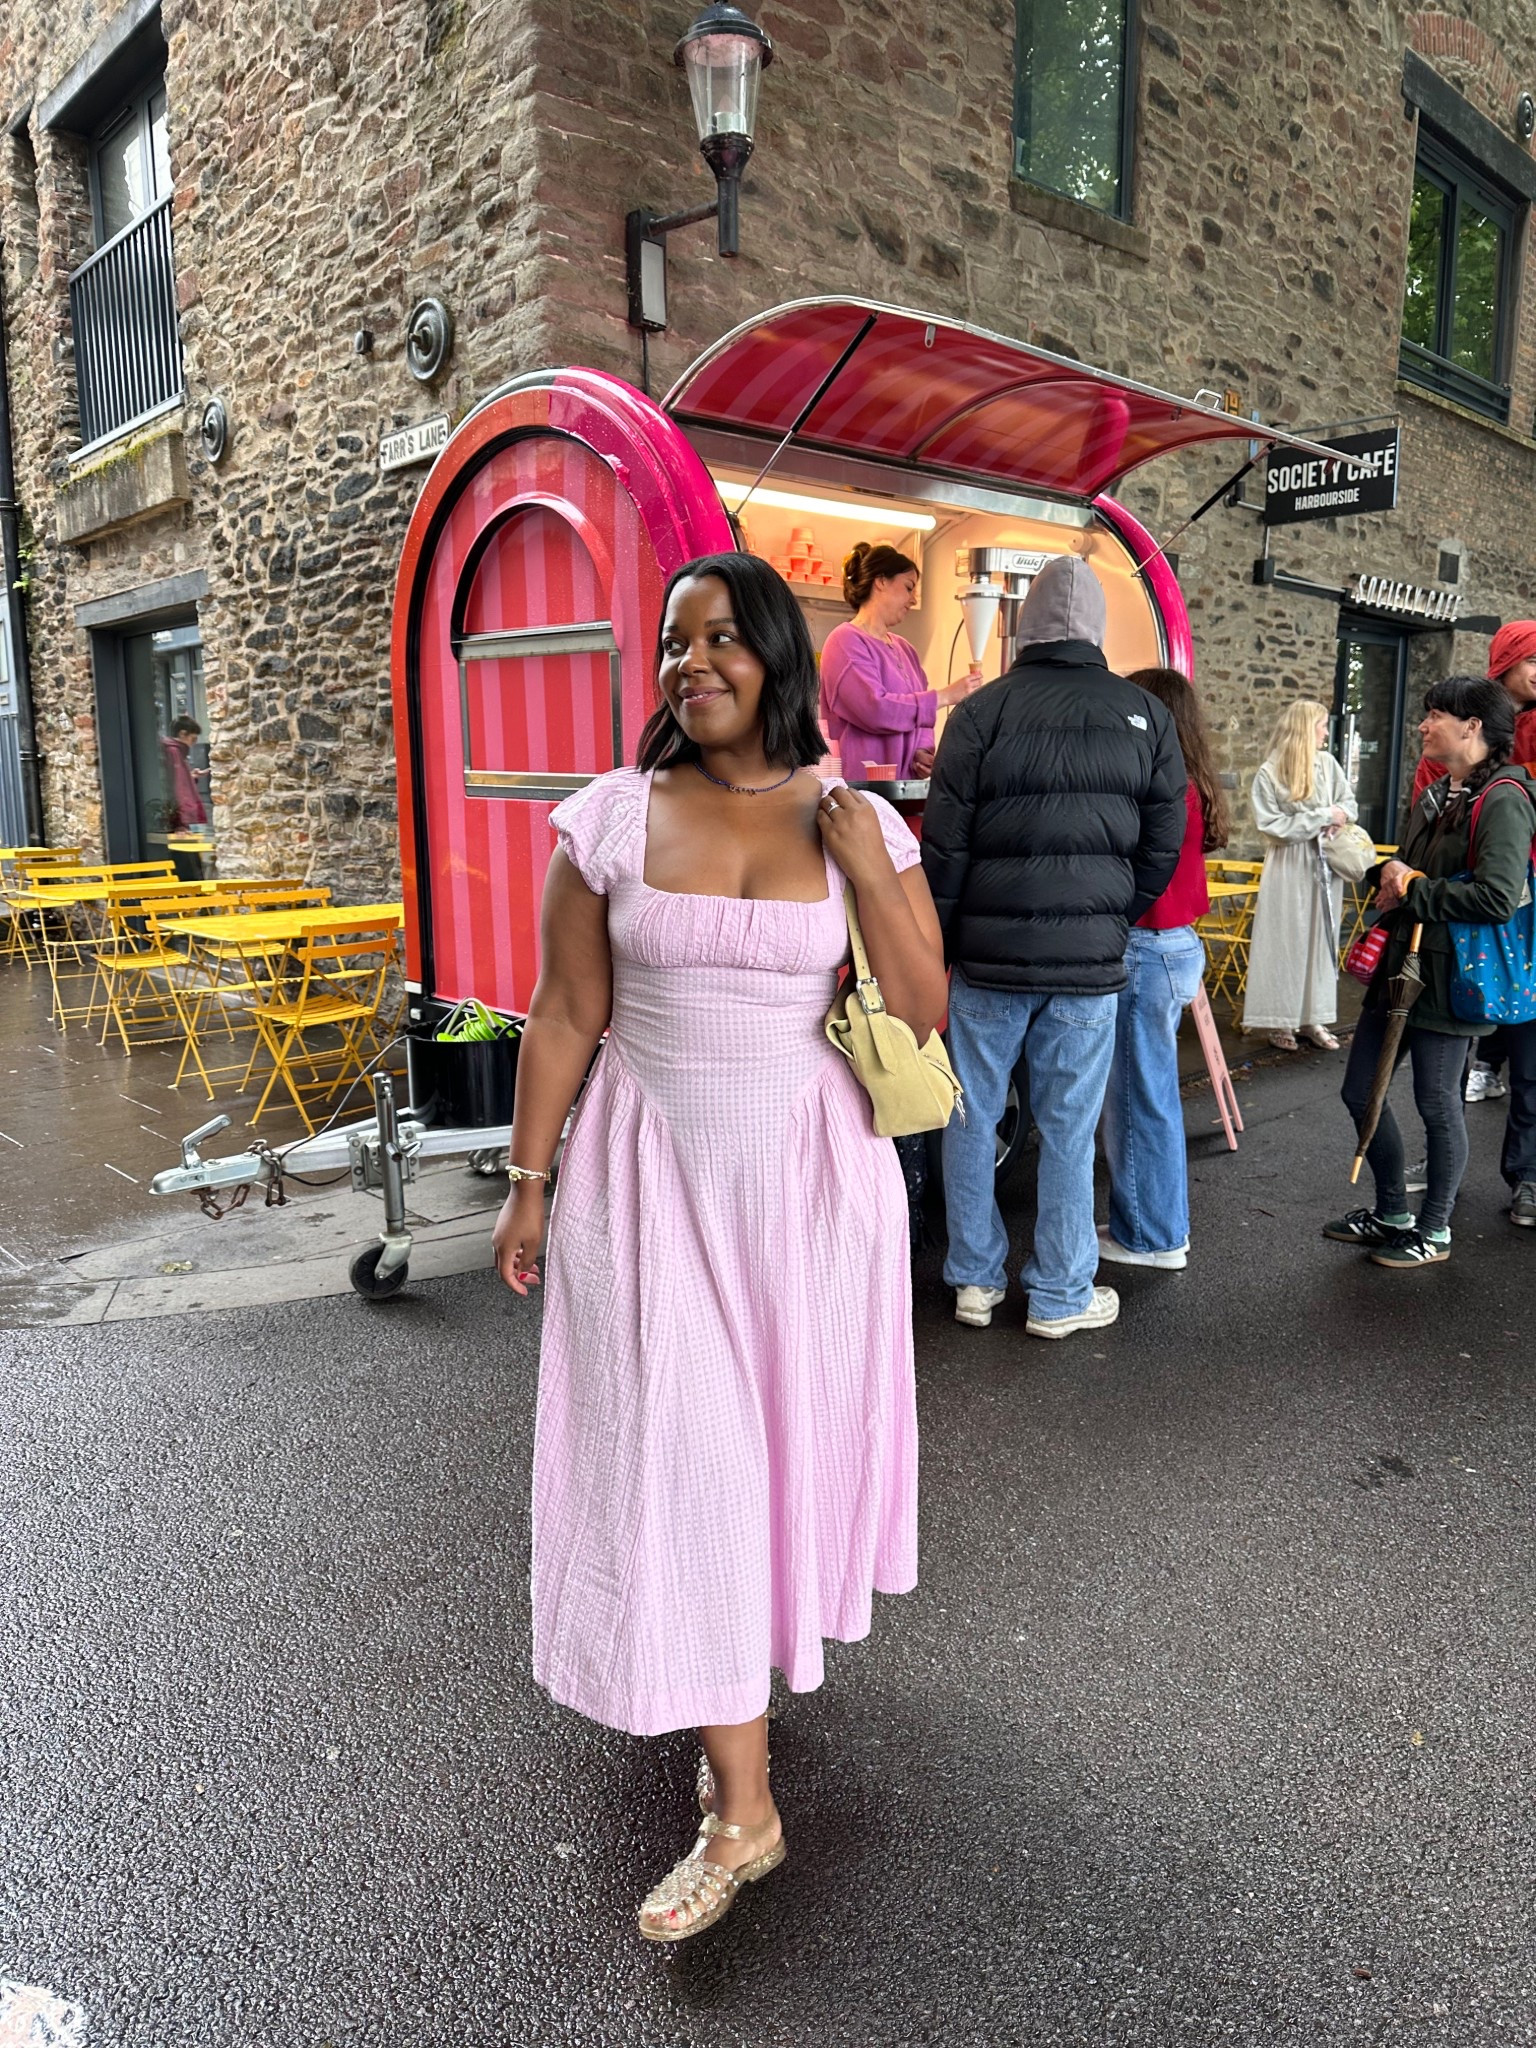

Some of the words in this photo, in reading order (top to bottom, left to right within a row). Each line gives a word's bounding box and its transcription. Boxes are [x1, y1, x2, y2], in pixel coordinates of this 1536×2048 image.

[382, 432, 414, 464] FARR'S
[419, 424, 444, 451] LANE
[1267, 459, 1342, 494] SOCIETY
[1347, 442, 1396, 482] CAFÉ
[1294, 487, 1360, 511] HARBOURSIDE
[1355, 574, 1422, 616] SOCIETY
